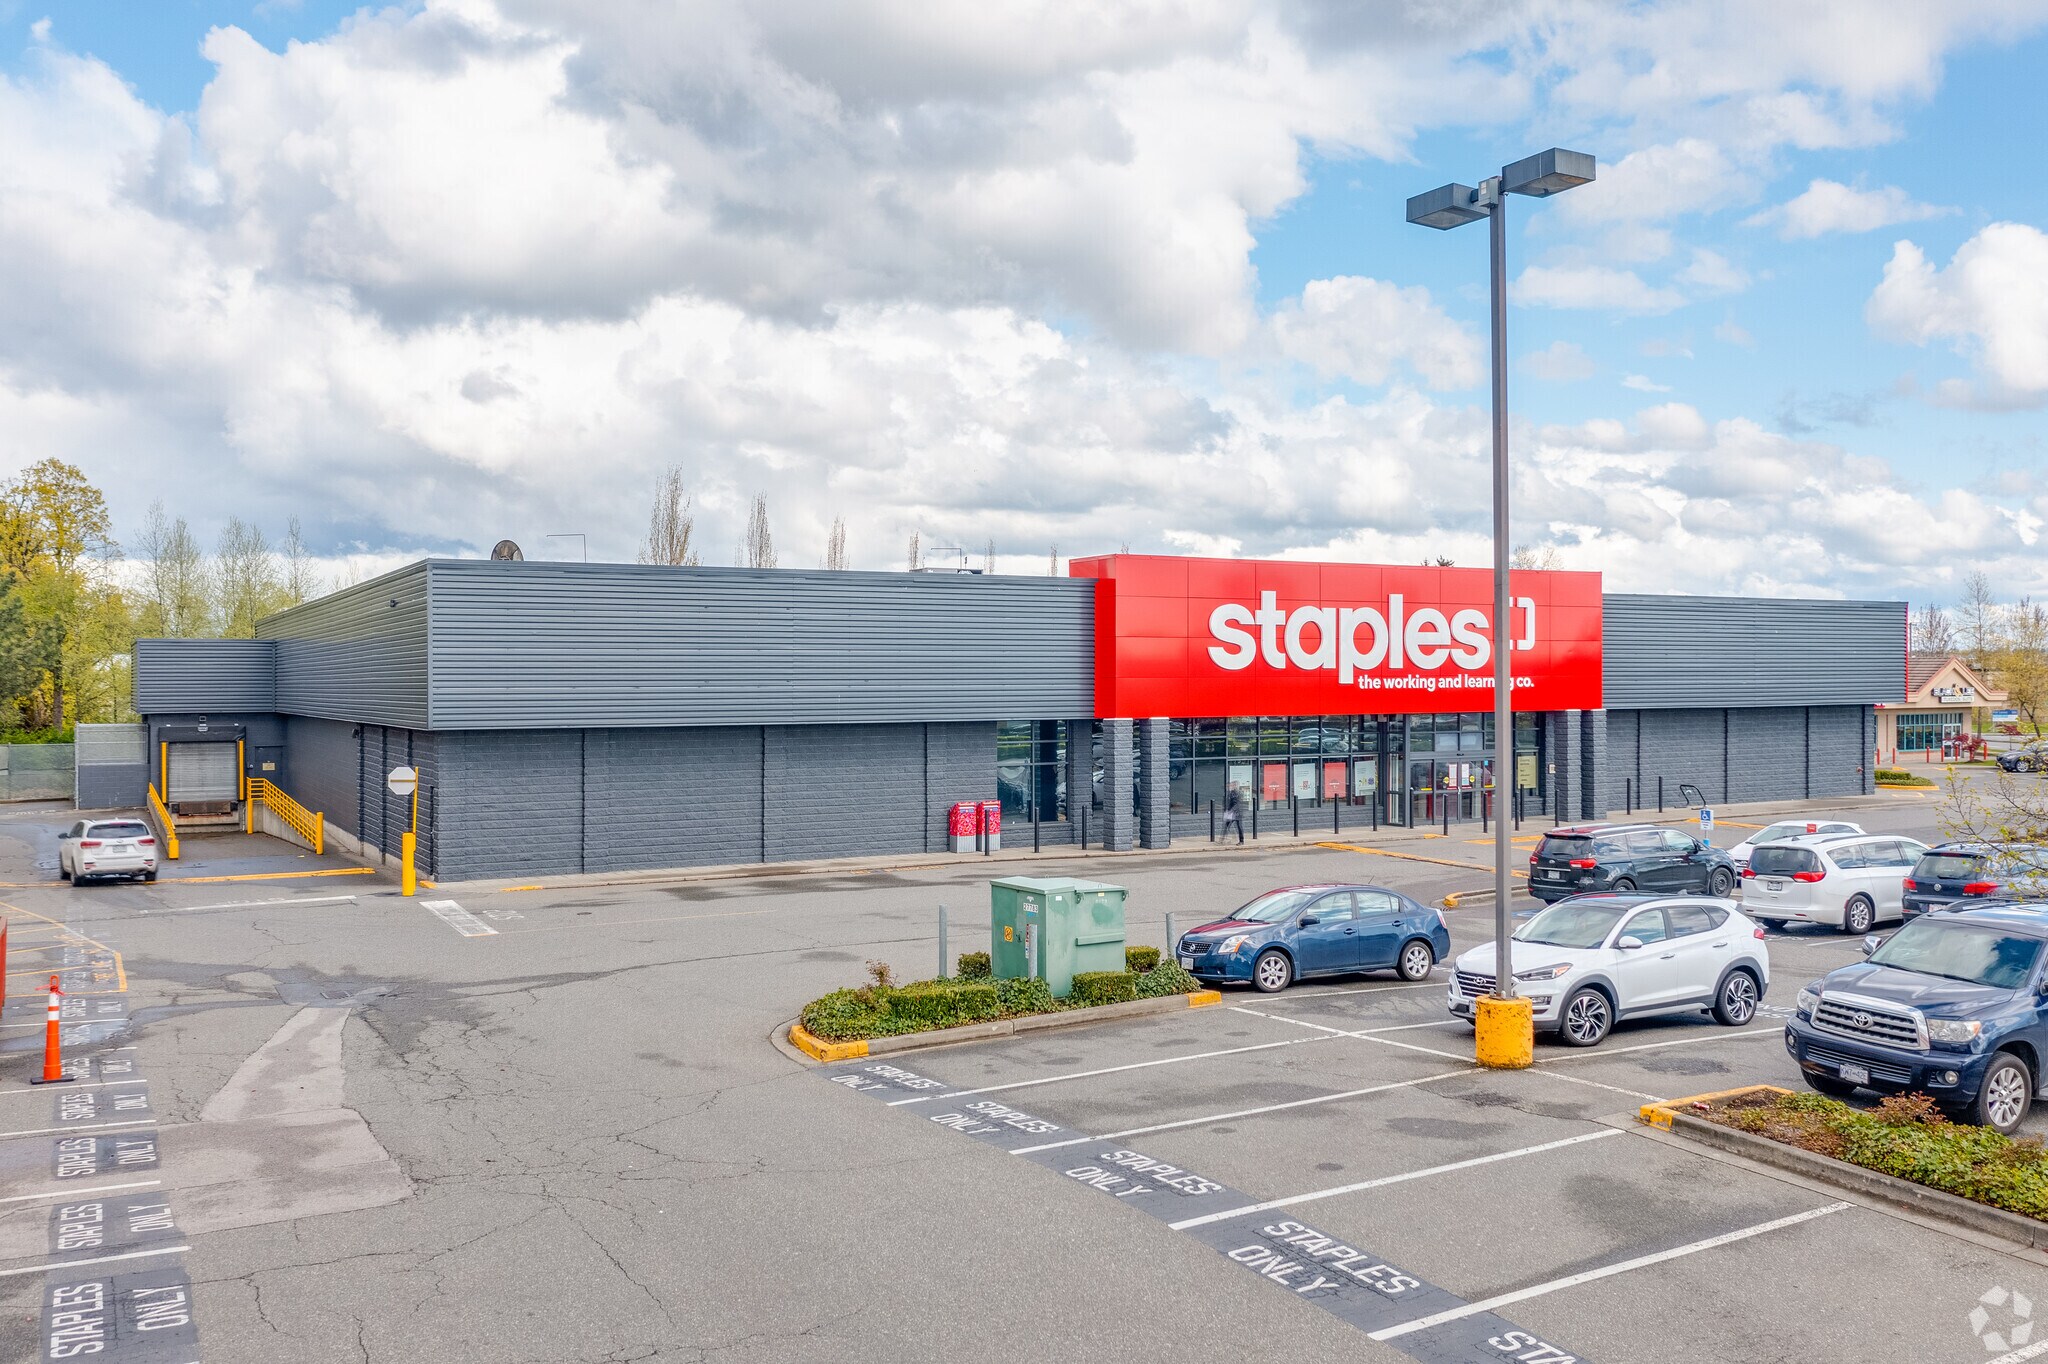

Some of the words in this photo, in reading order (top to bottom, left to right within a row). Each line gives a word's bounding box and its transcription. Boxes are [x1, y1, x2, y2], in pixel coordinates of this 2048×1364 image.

[1207, 590, 1491, 684] staples
[1358, 674, 1381, 689] the
[1383, 674, 1436, 692] working
[1438, 674, 1462, 689] and
[1464, 674, 1514, 691] learng
[1516, 676, 1535, 688] co.
[831, 1075, 890, 1092] ONLY
[864, 1065, 948, 1090] STAPLES
[61, 1093, 96, 1120] STAPLES
[113, 1094, 148, 1111] ONLY
[966, 1101, 1060, 1135] STAPLES
[930, 1113, 1000, 1135] ONLY
[57, 1137, 97, 1178] STAPLES
[116, 1138, 156, 1165] ONLY
[1065, 1166, 1153, 1197] ONLY
[1101, 1150, 1222, 1196] STAPLES
[58, 1203, 104, 1251] STAPLES
[128, 1203, 172, 1234] ONLY
[1227, 1244, 1340, 1293] ONLY
[1263, 1220, 1420, 1294] STAPLES
[50, 1281, 104, 1360] STAPLES
[133, 1287, 190, 1332] ONLY
